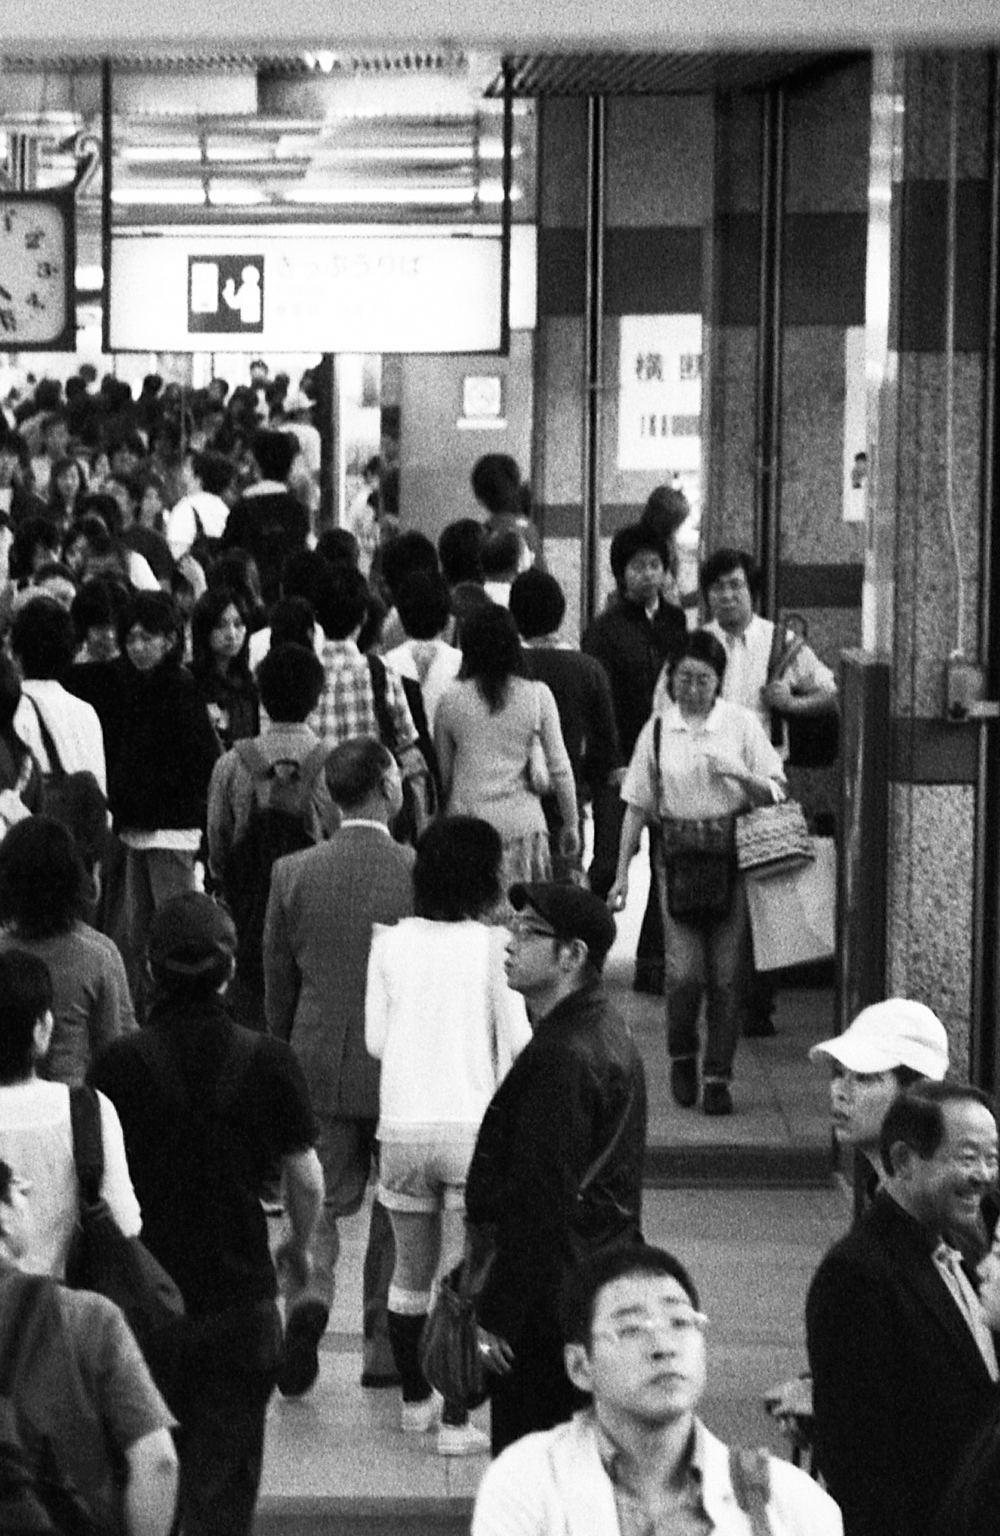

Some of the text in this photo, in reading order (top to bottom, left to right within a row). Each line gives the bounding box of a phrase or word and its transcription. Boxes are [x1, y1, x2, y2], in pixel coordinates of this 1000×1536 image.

[25, 231, 41, 250] 2
[37, 261, 53, 279] 3
[26, 292, 41, 308] 4
